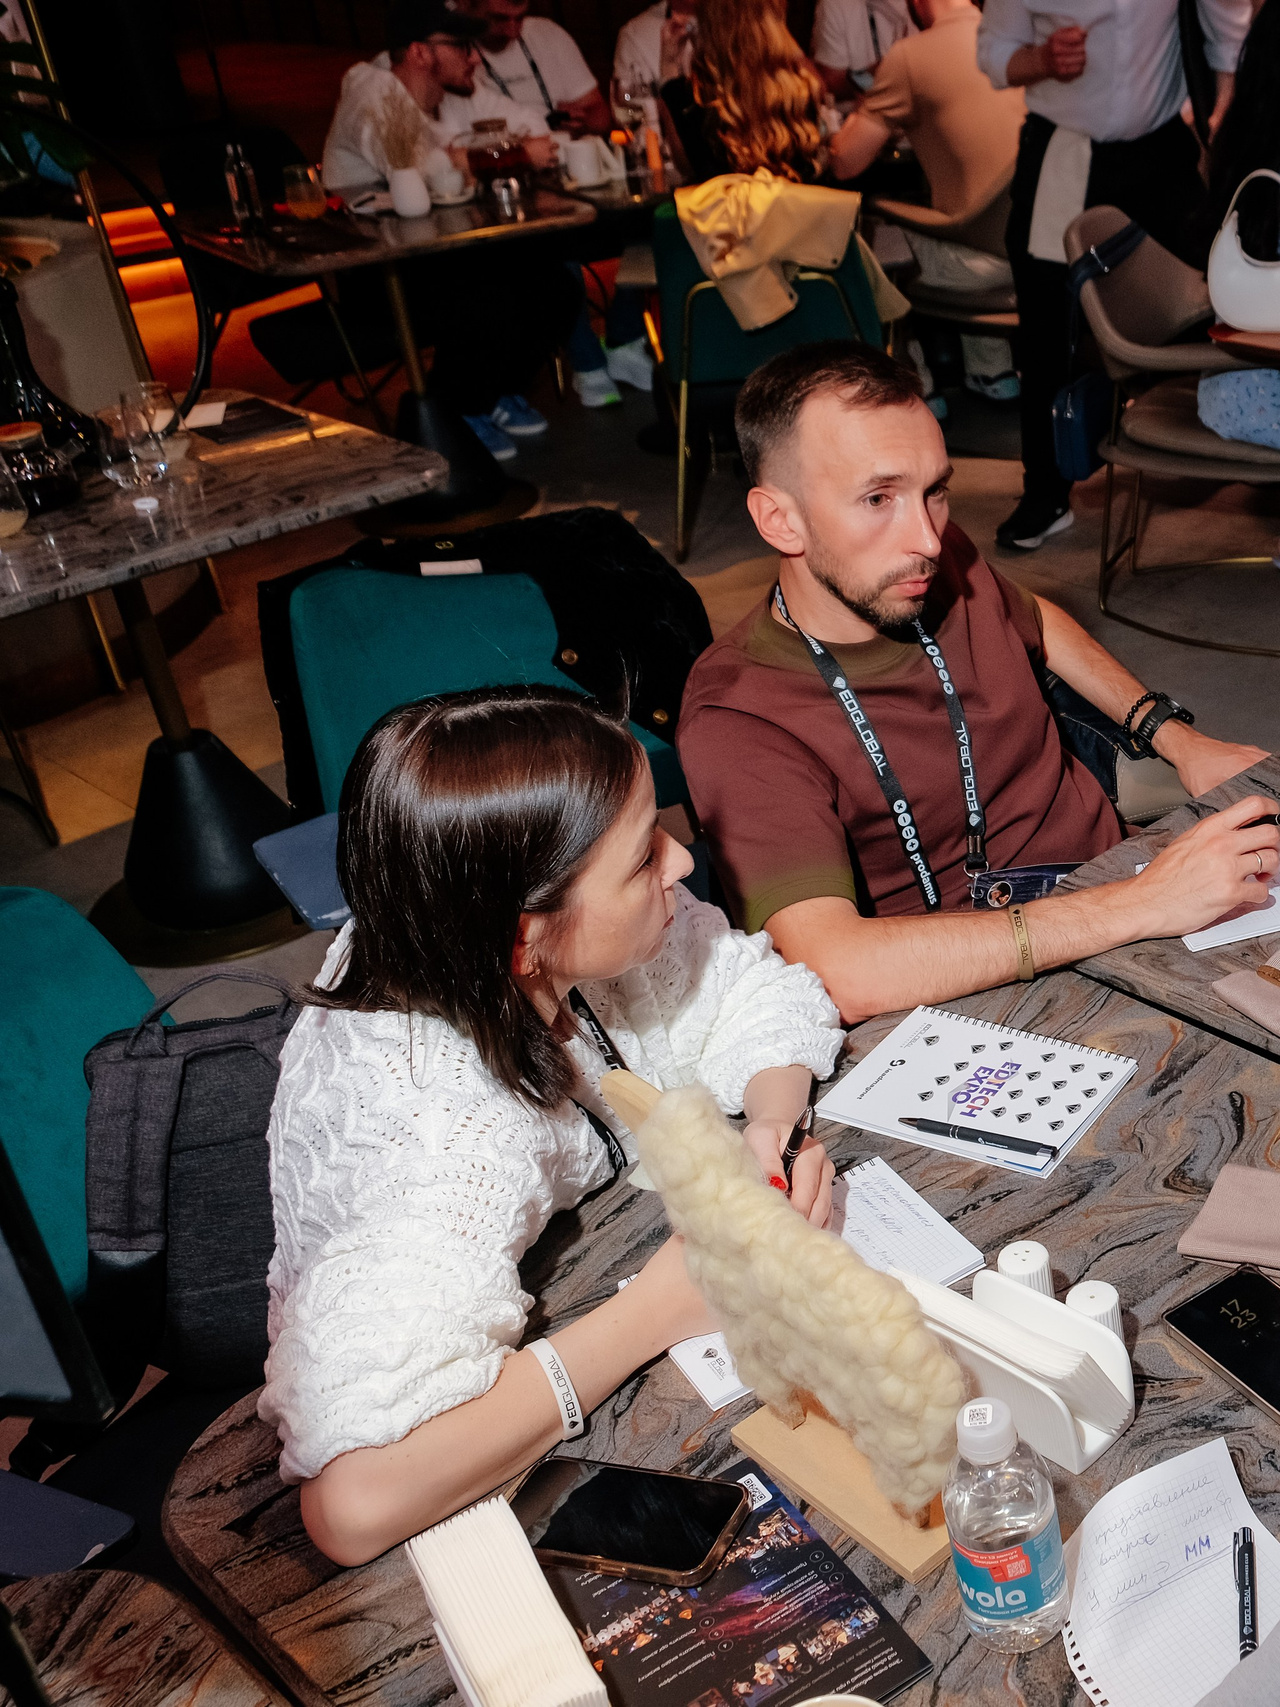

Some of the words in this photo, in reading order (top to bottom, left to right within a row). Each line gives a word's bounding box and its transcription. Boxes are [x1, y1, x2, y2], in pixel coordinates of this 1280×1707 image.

[838, 689, 887, 776] EDGLOBAL
[956, 722, 979, 811] EDGLOBAL
[910, 853, 937, 905] prodamus
[857, 1068, 893, 1100] leadmagnet
[951, 1066, 995, 1104] EXPO
[959, 1061, 1022, 1118] EDTECH
[1219, 1299, 1240, 1316] 17
[1230, 1309, 1257, 1329] 23
[548, 1354, 577, 1419] EDGLOBAL
[958, 1574, 1026, 1608] wola
[1243, 1585, 1252, 1625] EDGLOBAL
